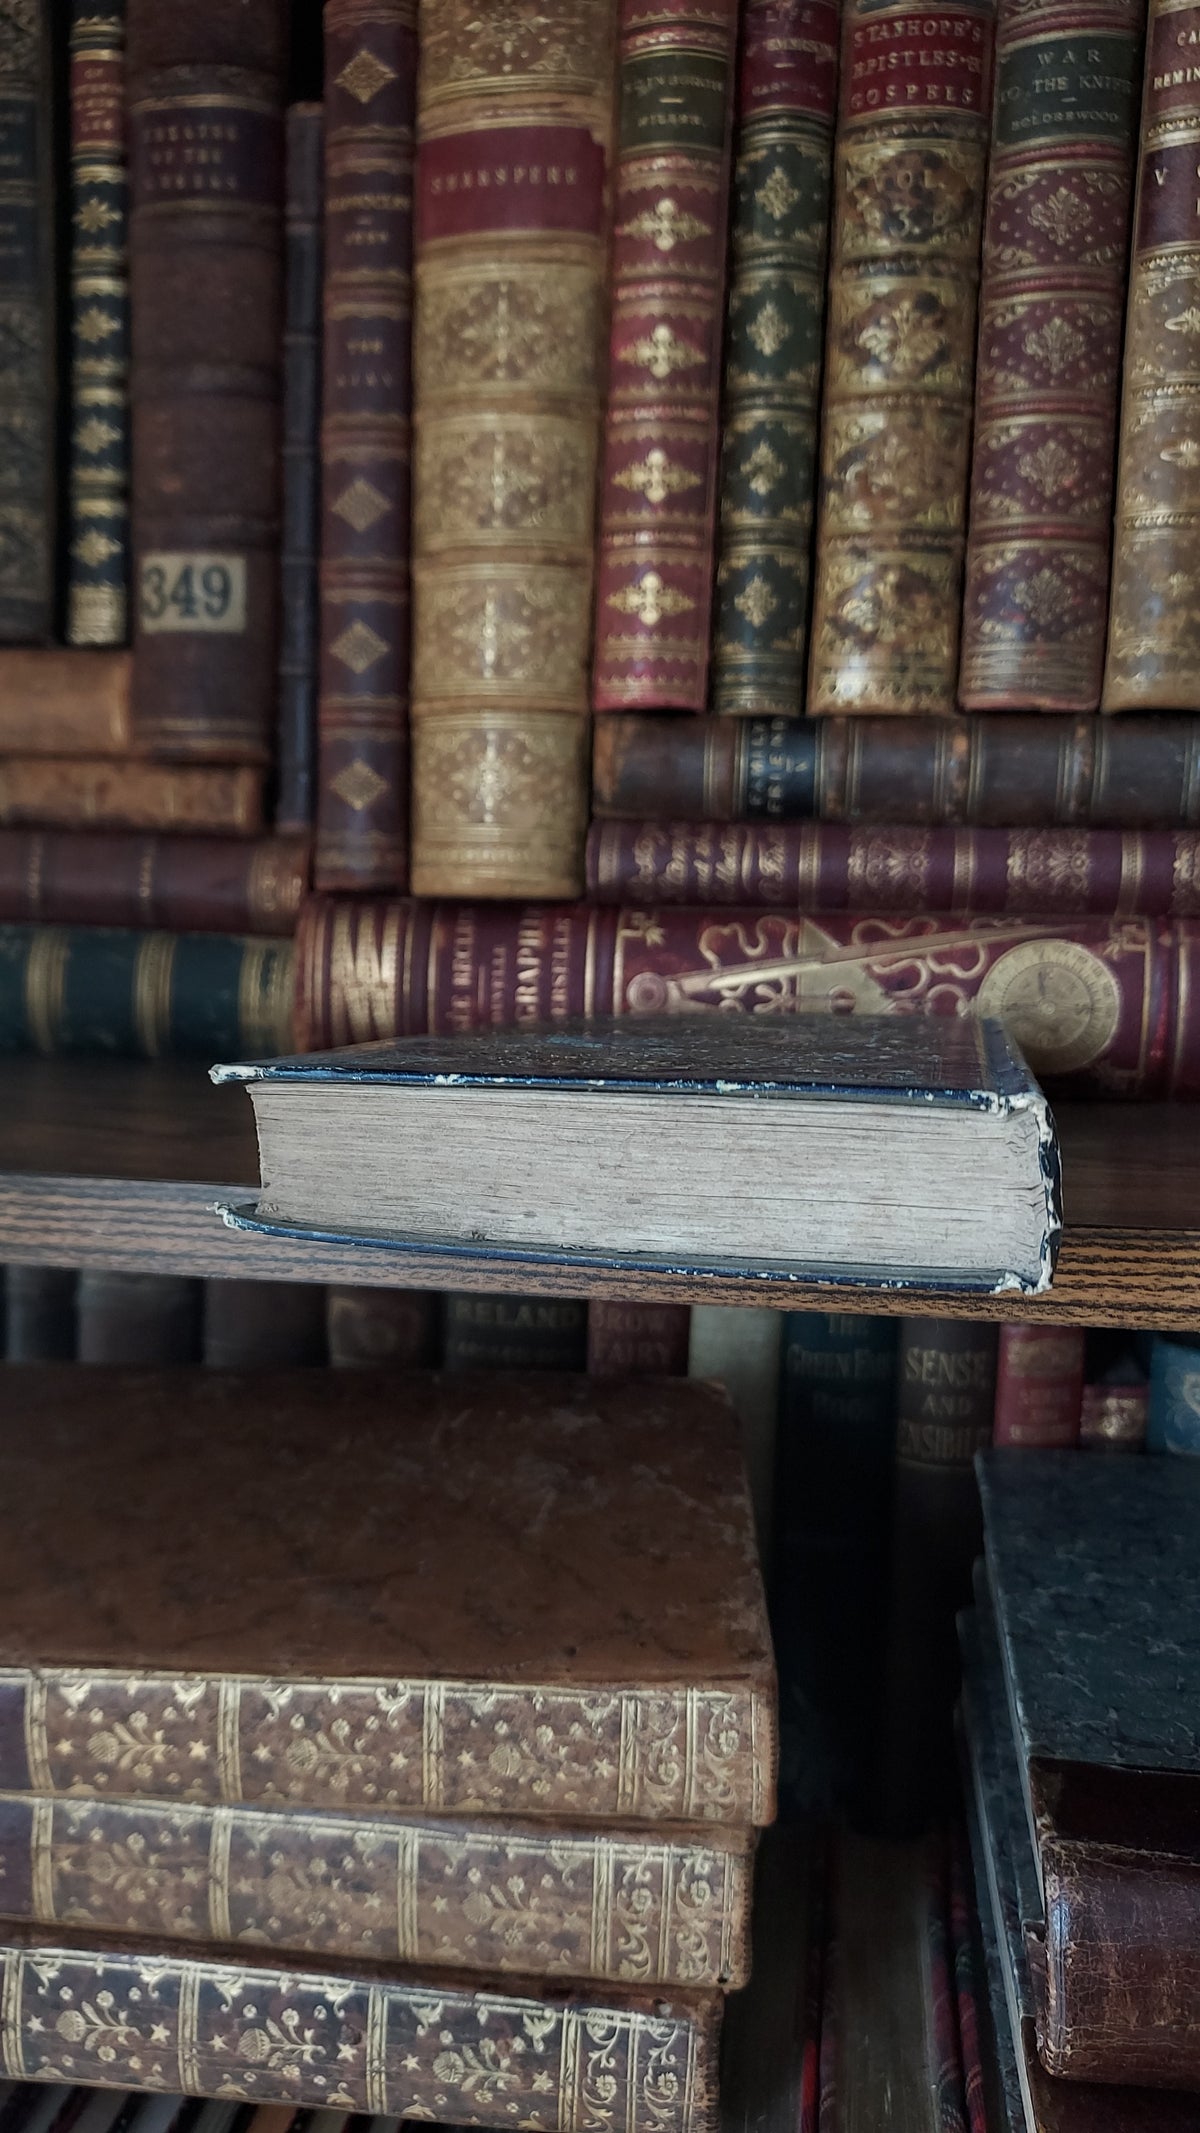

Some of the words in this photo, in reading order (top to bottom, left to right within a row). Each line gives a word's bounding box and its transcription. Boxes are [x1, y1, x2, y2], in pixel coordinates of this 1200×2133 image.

[853, 19, 982, 48] STANHOPE'S
[1036, 48, 1101, 65] WAR
[851, 83, 974, 110] GOSPELS
[1031, 76, 1070, 93] THE
[140, 564, 232, 620] 349
[905, 1346, 990, 1390] SENSE
[921, 1393, 974, 1418] AND
